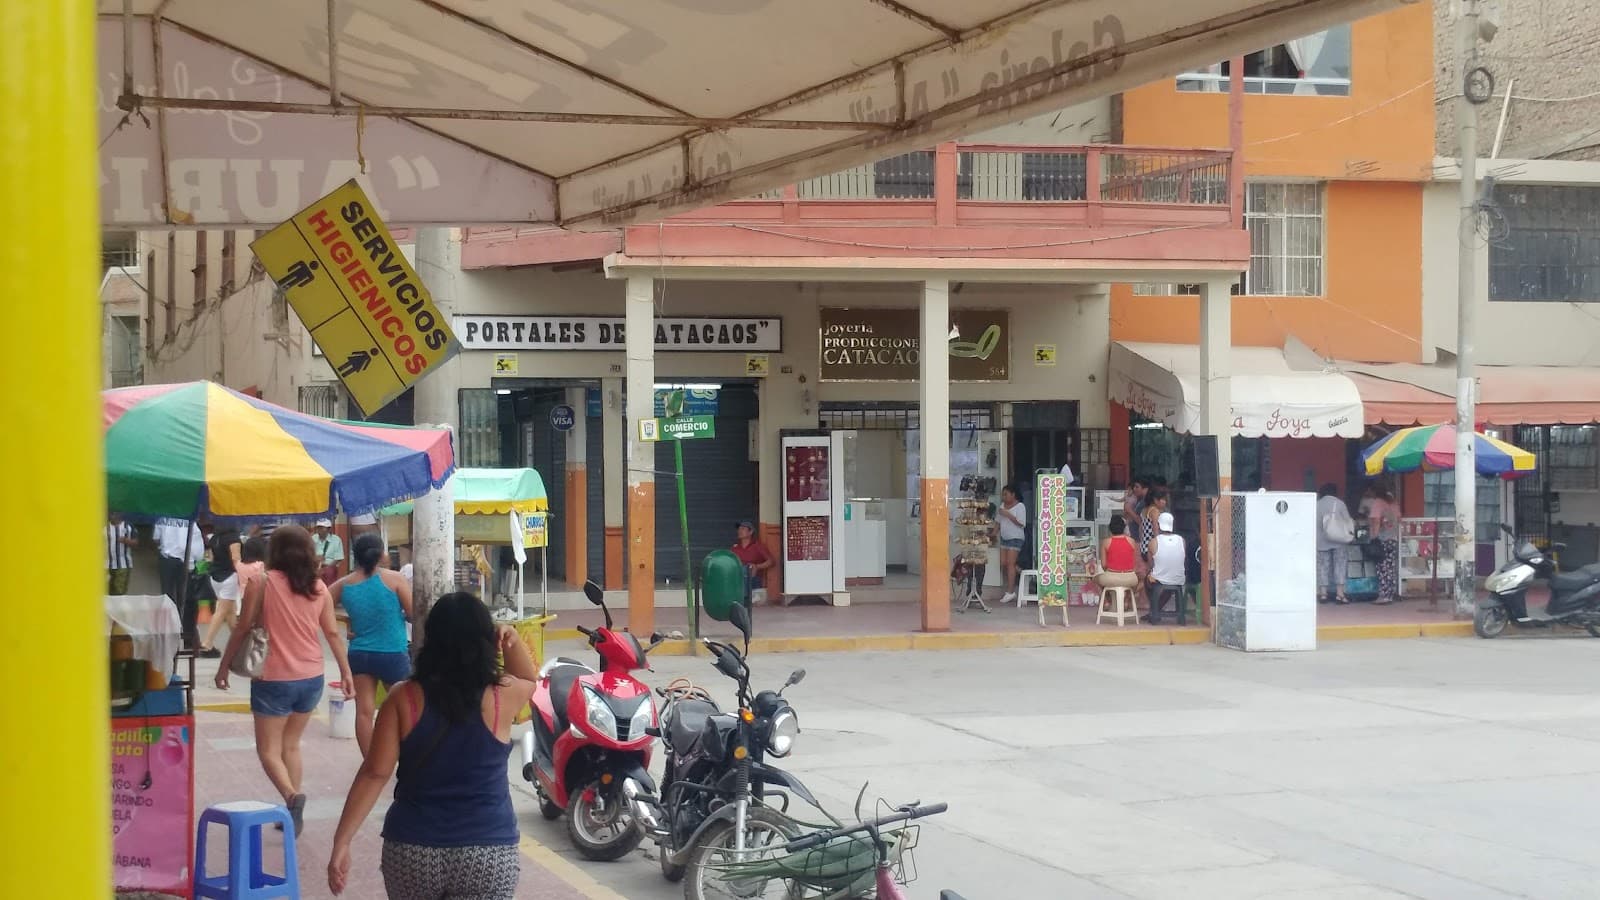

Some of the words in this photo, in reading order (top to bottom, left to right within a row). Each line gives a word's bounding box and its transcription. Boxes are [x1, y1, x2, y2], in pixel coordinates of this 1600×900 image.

[341, 201, 447, 351] SERVICIOS
[307, 209, 427, 375] HIGIENICOS
[466, 321, 586, 344] PORTALES
[599, 323, 626, 344] DE
[654, 320, 769, 345] ATACAOS"
[824, 337, 919, 348] PRODUCCIONE
[823, 348, 920, 365] CATACAO
[553, 417, 573, 425] VISA
[663, 421, 709, 433] COMERCIO
[1266, 408, 1311, 436] Joya
[1040, 476, 1053, 586] CREMOLADAS
[1054, 476, 1066, 586] RASPADILLAS
[111, 763, 125, 774] SA
[112, 794, 153, 807] ARINDO
[111, 809, 132, 820] ELA
